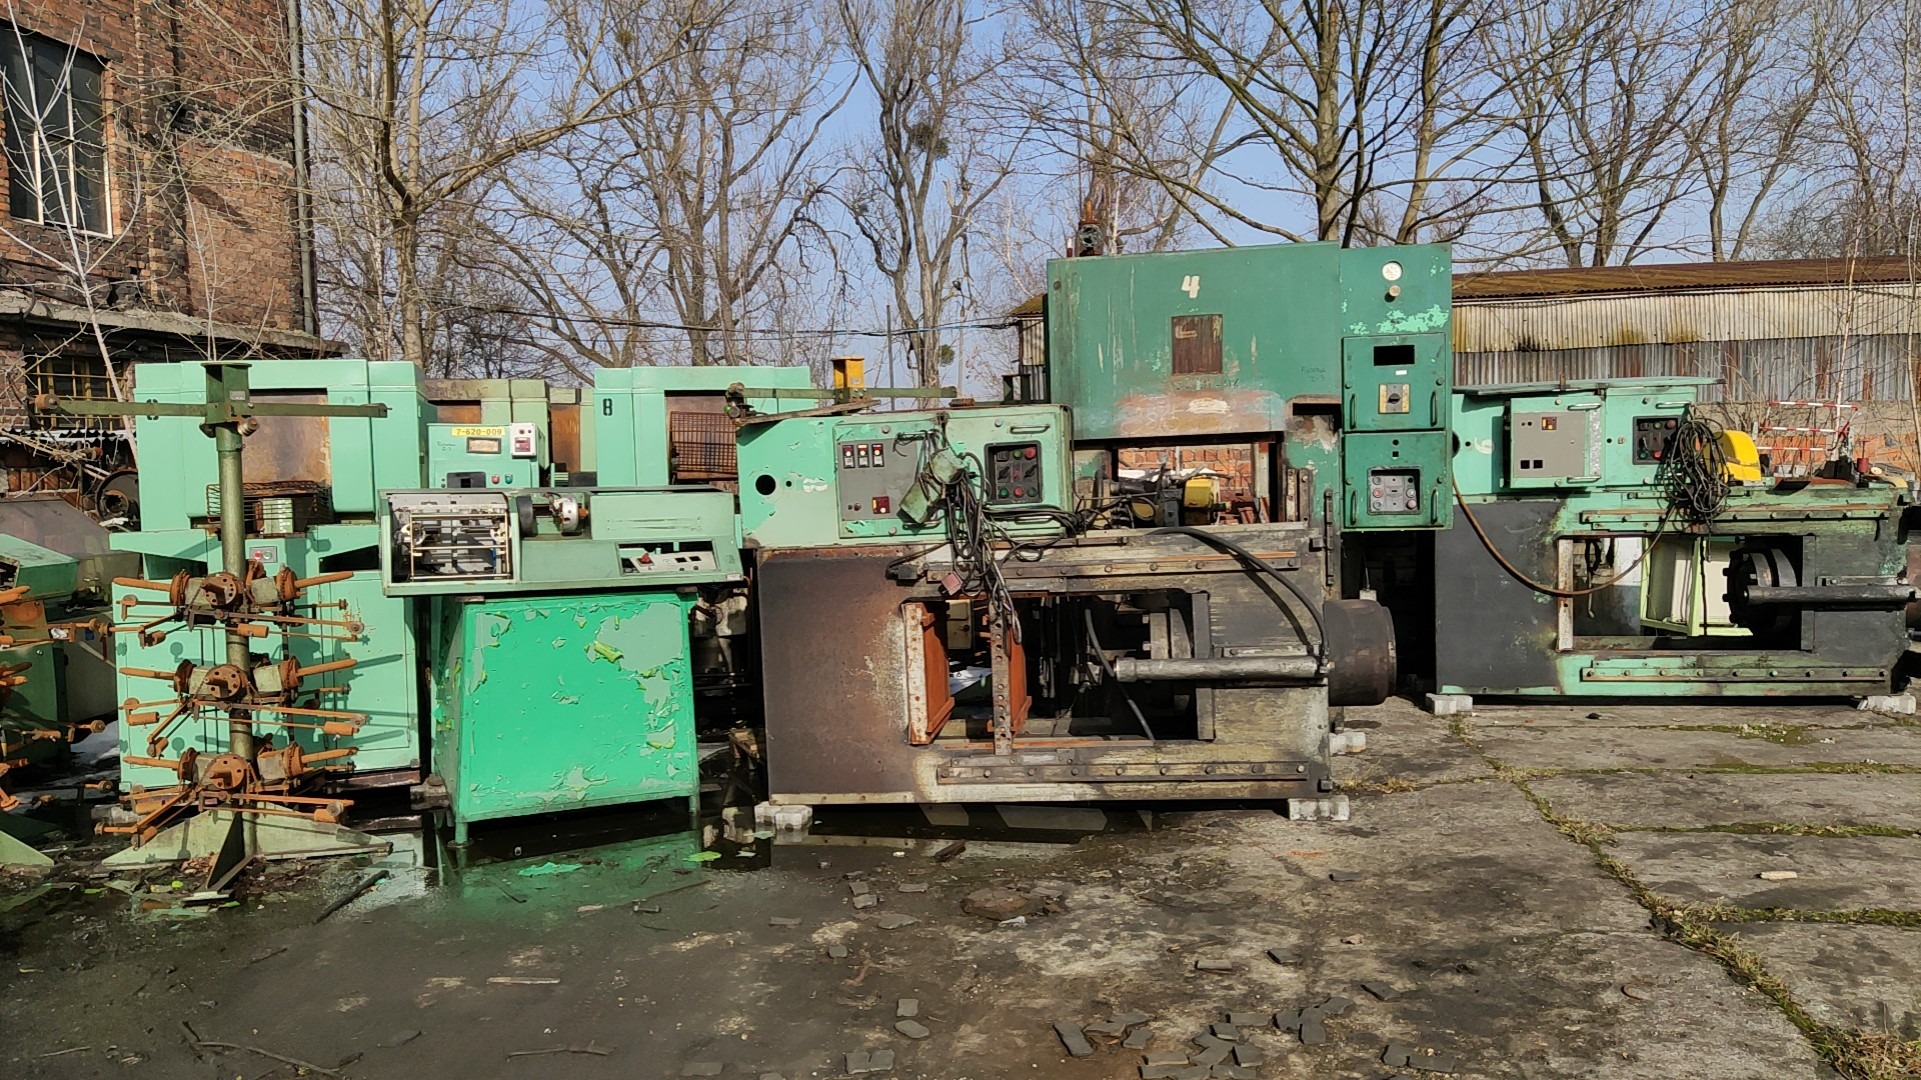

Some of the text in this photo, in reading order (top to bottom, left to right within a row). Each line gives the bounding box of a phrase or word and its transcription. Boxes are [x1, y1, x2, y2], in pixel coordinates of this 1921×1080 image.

[1181, 275, 1201, 299] 4
[602, 398, 613, 416] 8
[455, 428, 503, 436] 7-620-009
